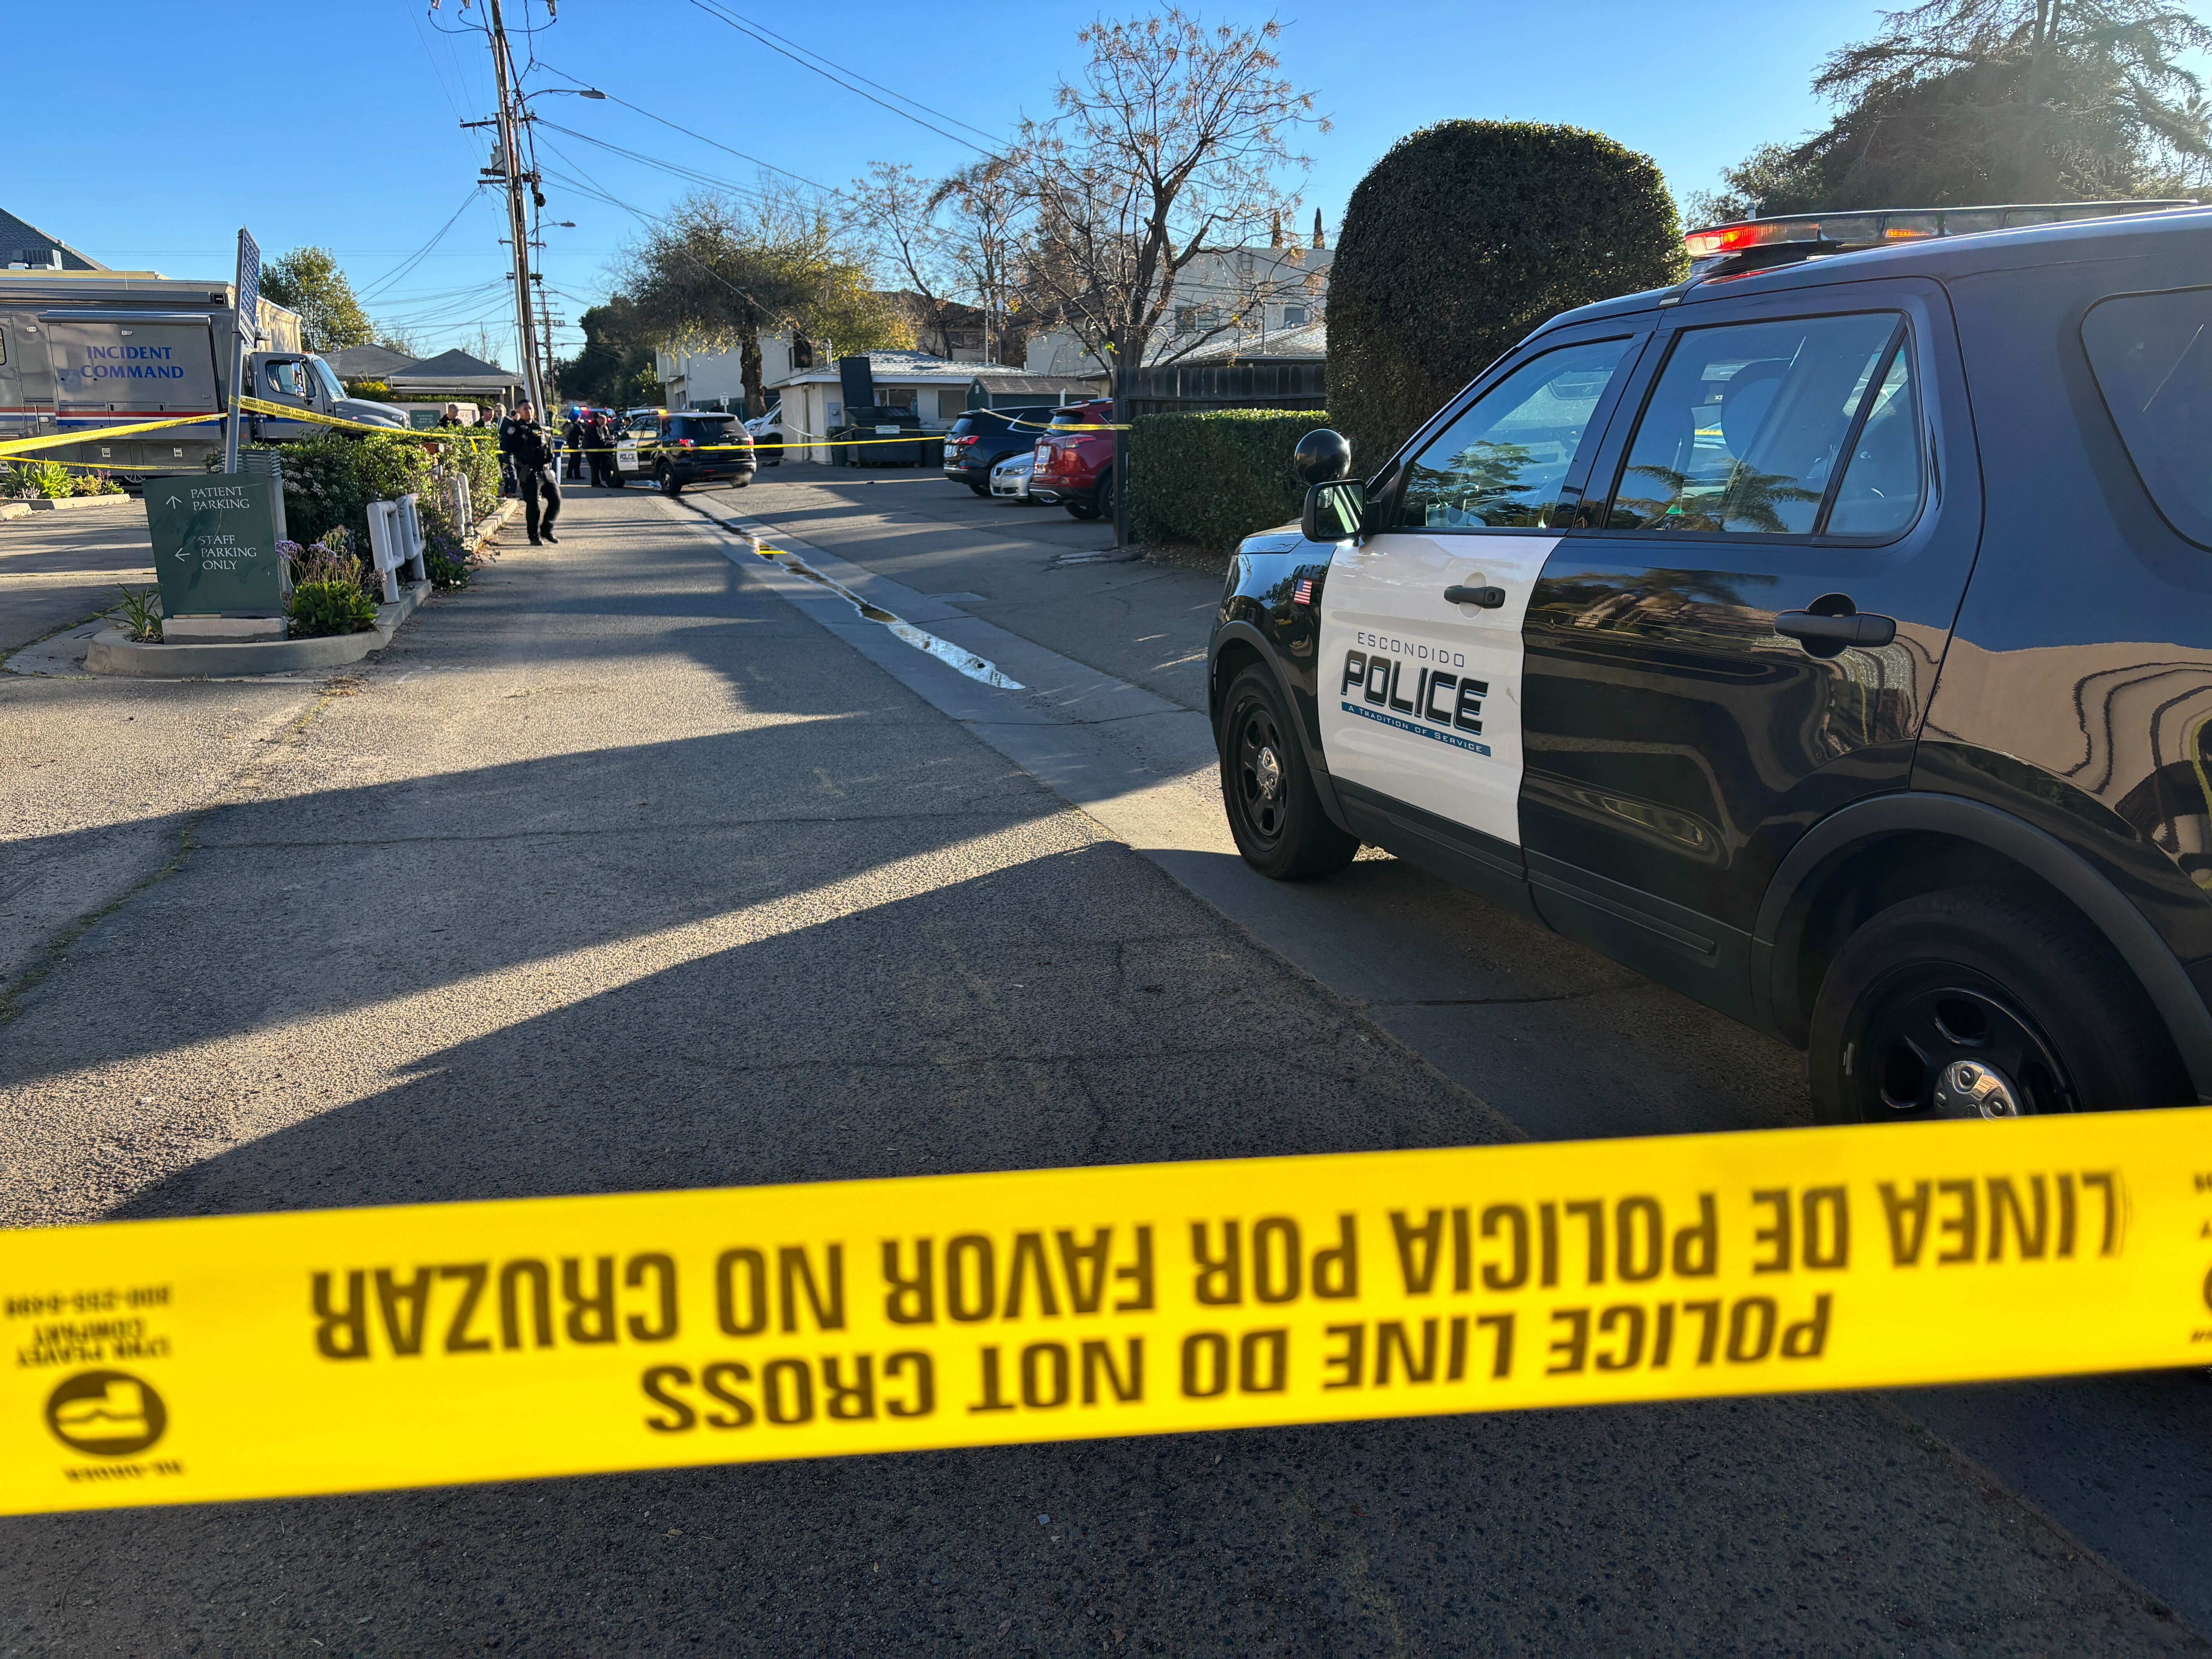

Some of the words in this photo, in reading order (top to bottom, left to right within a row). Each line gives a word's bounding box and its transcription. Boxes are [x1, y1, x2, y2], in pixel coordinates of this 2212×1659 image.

[81, 364, 184, 378] COMMAND
[88, 346, 172, 359] INCIDENT
[191, 486, 243, 498] PATIENT
[193, 498, 250, 510] PARKING
[198, 535, 235, 544] STAFF
[201, 547, 257, 558] PARKING
[203, 560, 237, 570] ONLY
[1358, 632, 1465, 667] ESCONDIDO
[1341, 649, 1490, 736] POLICE
[1389, 1193, 1718, 1295] POLICIA
[1752, 1186, 1850, 1274] DE
[1878, 1172, 2116, 1266] LINEA
[716, 1243, 845, 1337] NO
[881, 1225, 1154, 1326] FAVOR
[1190, 1214, 1358, 1306] POR
[312, 1252, 679, 1361] CRUZAR
[1545, 1295, 1832, 1376] POLICE
[969, 1338, 1143, 1413] NOT
[1181, 1329, 1287, 1398] DO
[1322, 1314, 1514, 1390] LINE
[641, 1351, 935, 1433] CROSS
